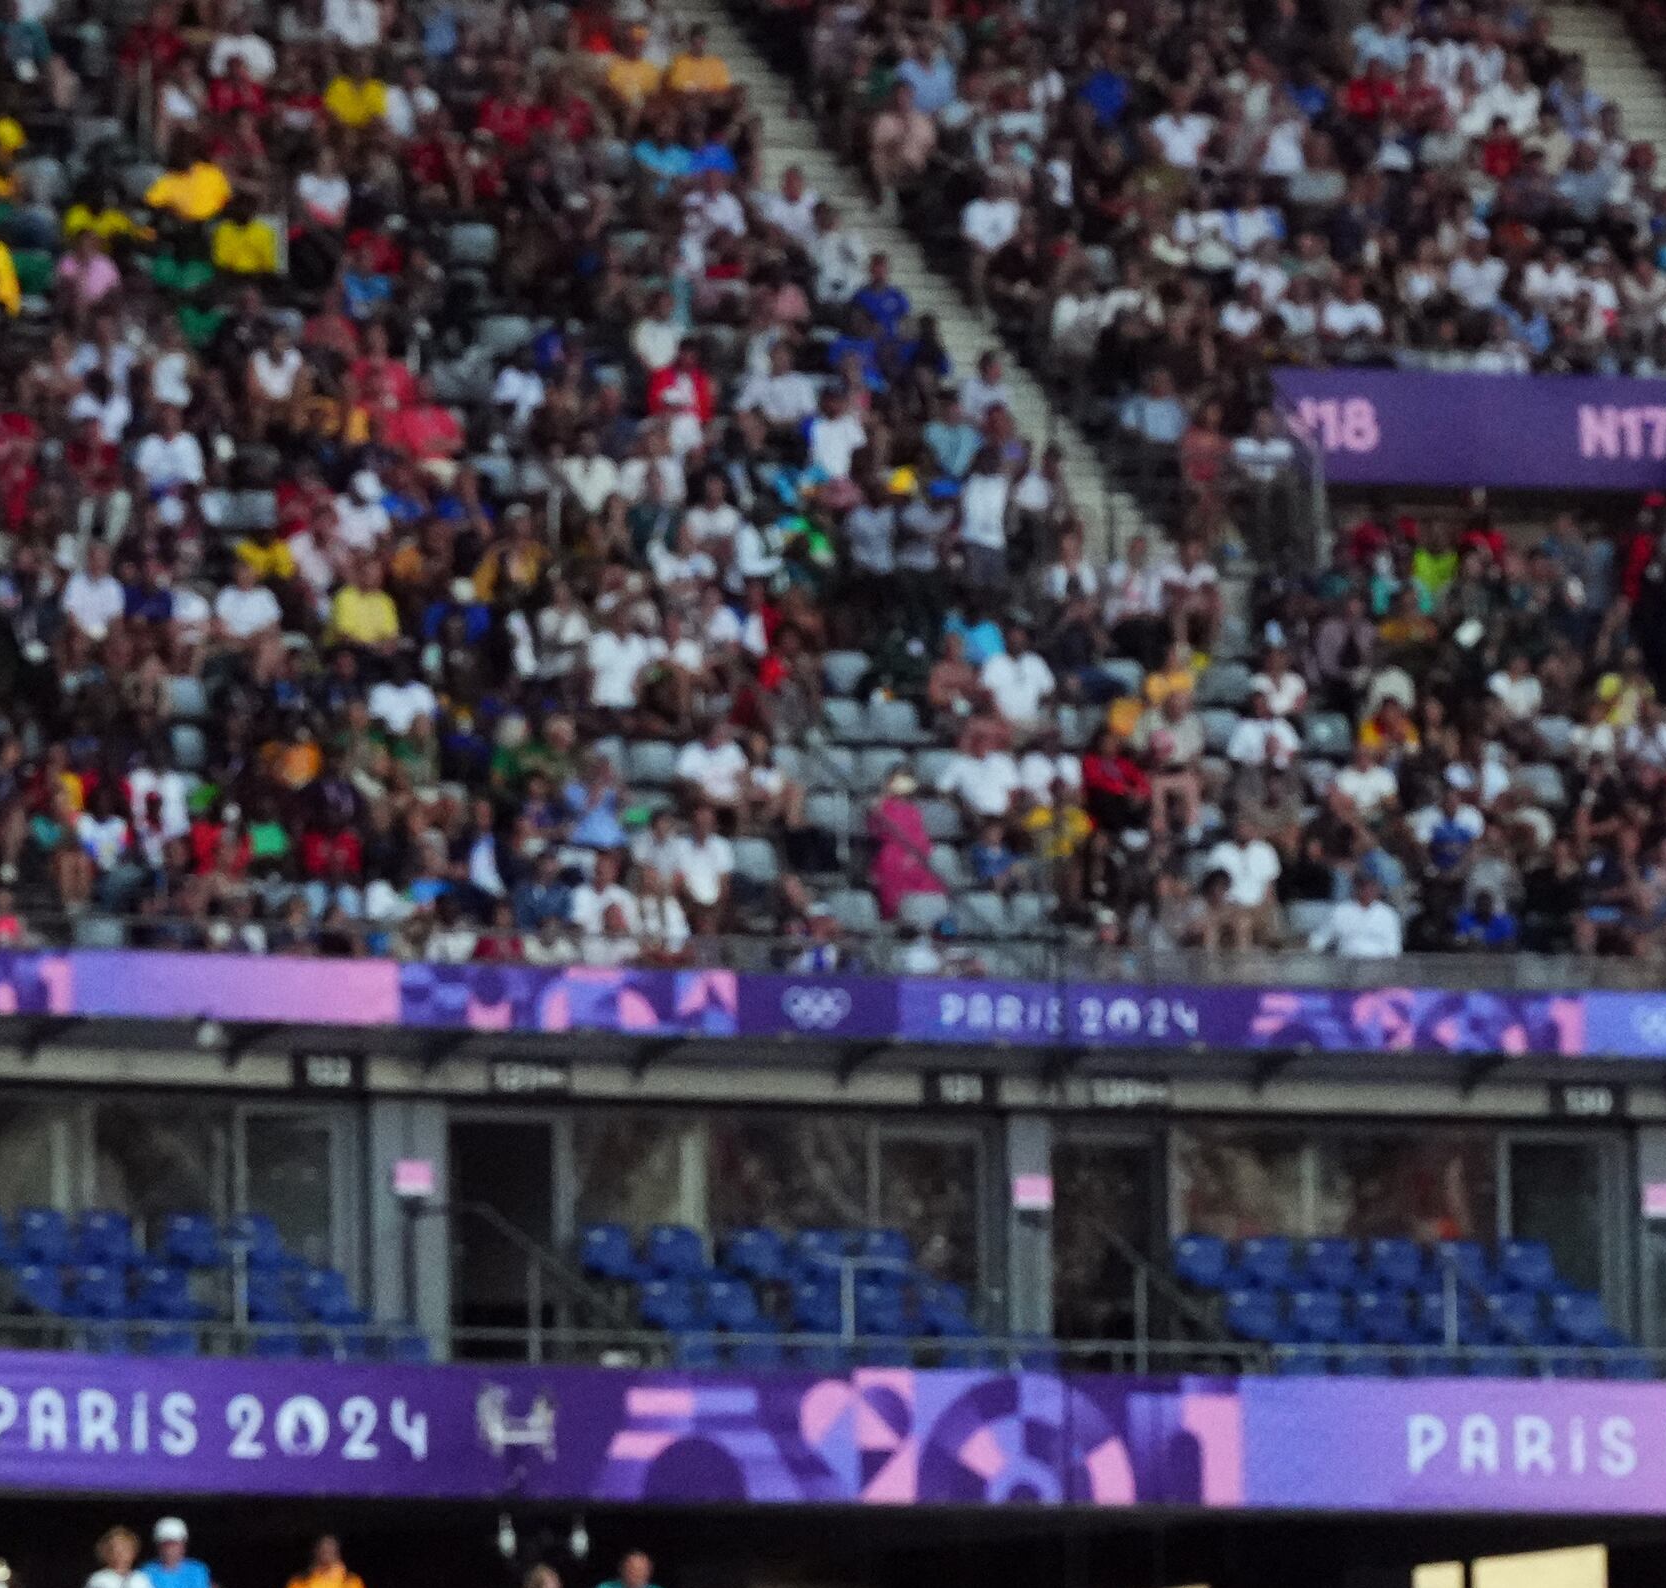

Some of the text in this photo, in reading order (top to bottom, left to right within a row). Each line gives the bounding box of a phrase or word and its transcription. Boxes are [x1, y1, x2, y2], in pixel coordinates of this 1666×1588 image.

[940, 993, 1198, 1037] PARIS 2024
[225, 1393, 428, 1461] 2024
[1406, 1412, 1637, 1477] PARIS
